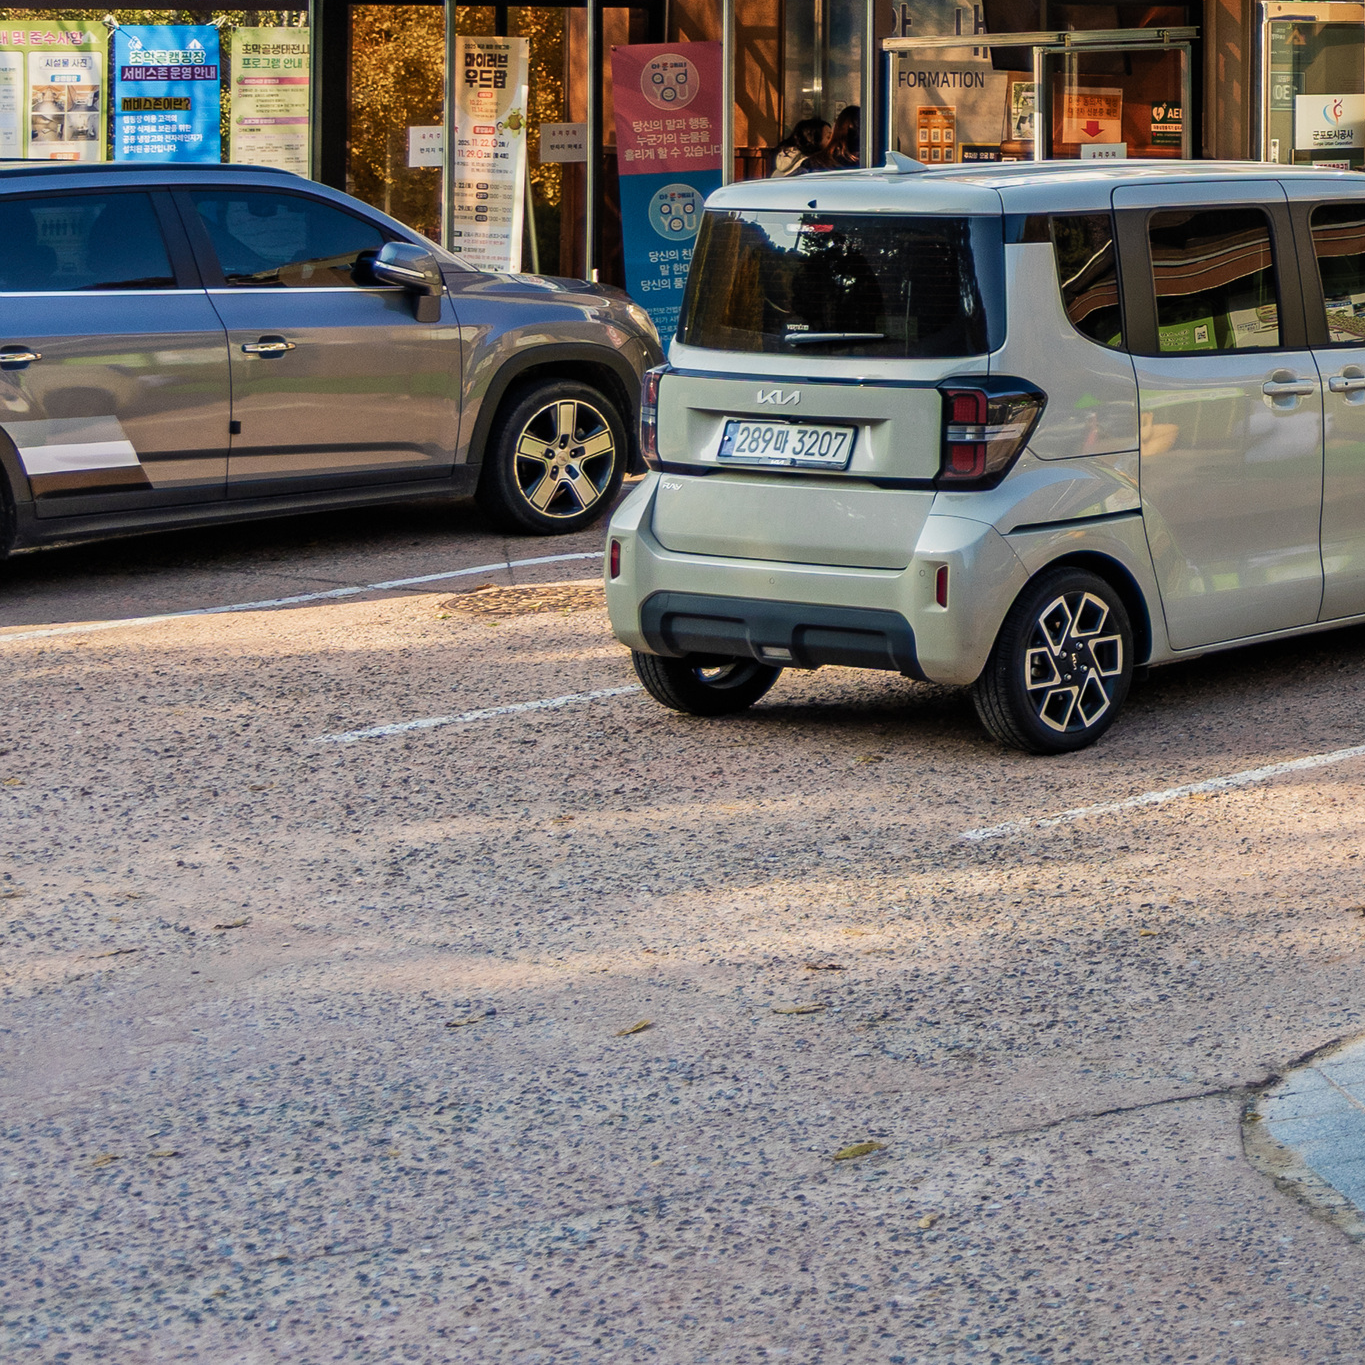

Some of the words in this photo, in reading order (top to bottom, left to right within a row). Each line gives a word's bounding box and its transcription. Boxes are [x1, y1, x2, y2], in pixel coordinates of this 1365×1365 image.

[12, 31, 26, 45] 및
[29, 31, 84, 45] 준수사항
[242, 43, 310, 55] 초막골생태전시
[242, 58, 281, 69] 프로그램
[283, 58, 302, 69] 안내
[464, 53, 508, 68] 마이러브
[123, 67, 168, 80] 서비스존
[170, 67, 192, 80] 운영
[193, 67, 216, 80] 안내
[632, 119, 663, 133] 당신의
[665, 118, 687, 131] 말과
[688, 117, 712, 129] 행동,
[636, 133, 677, 146] 누군가의
[679, 131, 711, 144] 눈물을
[1312, 130, 1354, 140] 군포도시공사
[657, 147, 668, 159] 할
[670, 146, 681, 158] 수
[648, 249, 679, 263] 당신의
[681, 248, 695, 260] 친
[659, 264, 670, 276] 말
[640, 279, 671, 292] 당신의
[756, 389, 801, 406] KIA
[735, 425, 790, 454] 289마
[791, 428, 848, 458] 3207
